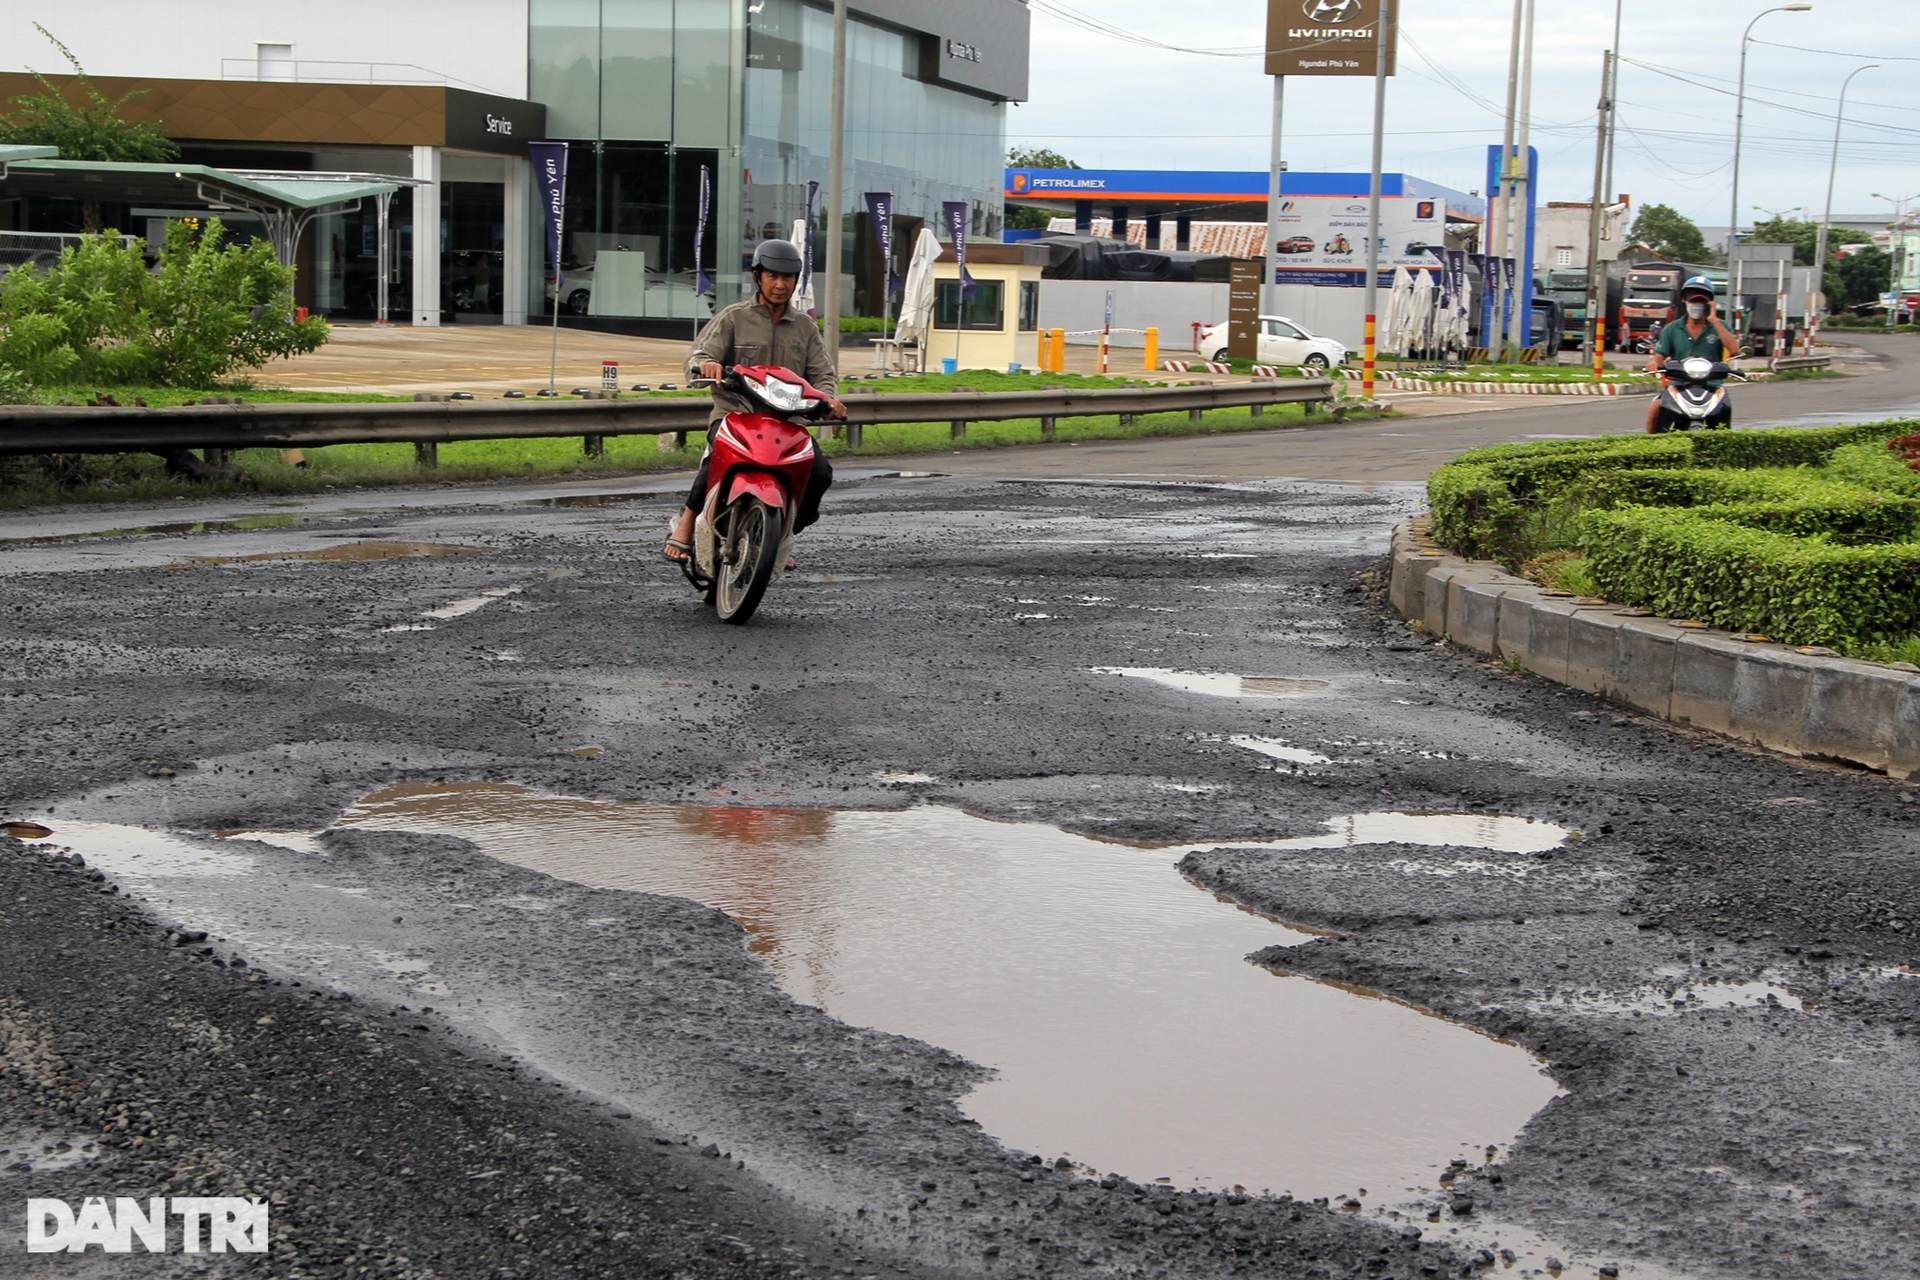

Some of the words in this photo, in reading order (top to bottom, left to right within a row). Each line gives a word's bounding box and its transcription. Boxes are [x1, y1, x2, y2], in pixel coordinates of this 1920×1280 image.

[1299, 60, 1327, 68] Hyundai
[486, 114, 512, 135] Service
[546, 159, 558, 184] Yên
[1033, 179, 1105, 188] PETROLIMEX
[549, 189, 561, 214] Phú
[876, 203, 887, 221] Yên
[953, 211, 962, 229] Yên
[880, 225, 889, 244] Phú
[603, 366, 617, 379] H9
